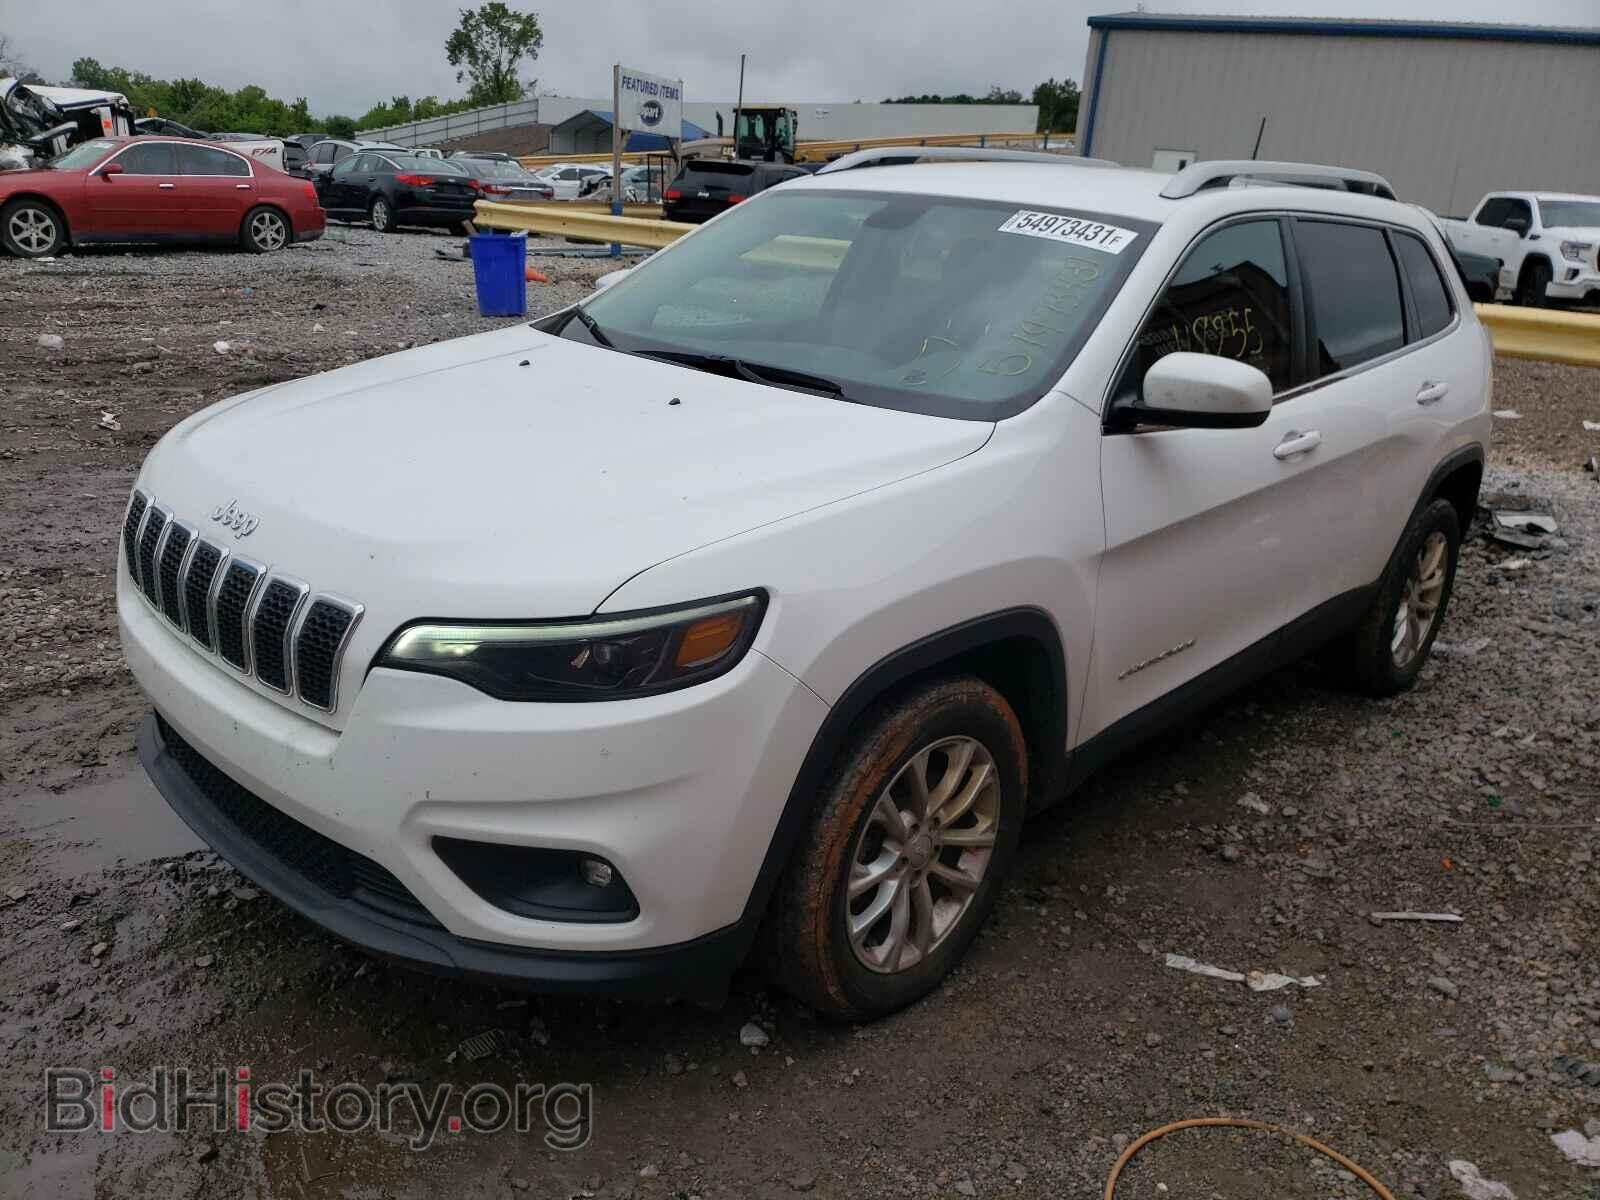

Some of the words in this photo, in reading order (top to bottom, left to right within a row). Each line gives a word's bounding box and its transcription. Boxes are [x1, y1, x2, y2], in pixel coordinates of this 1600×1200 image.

[621, 76, 659, 96] FEATURED
[660, 85, 680, 101] ITEMS
[252, 147, 277, 156] FX4
[210, 499, 260, 540] Jeep
